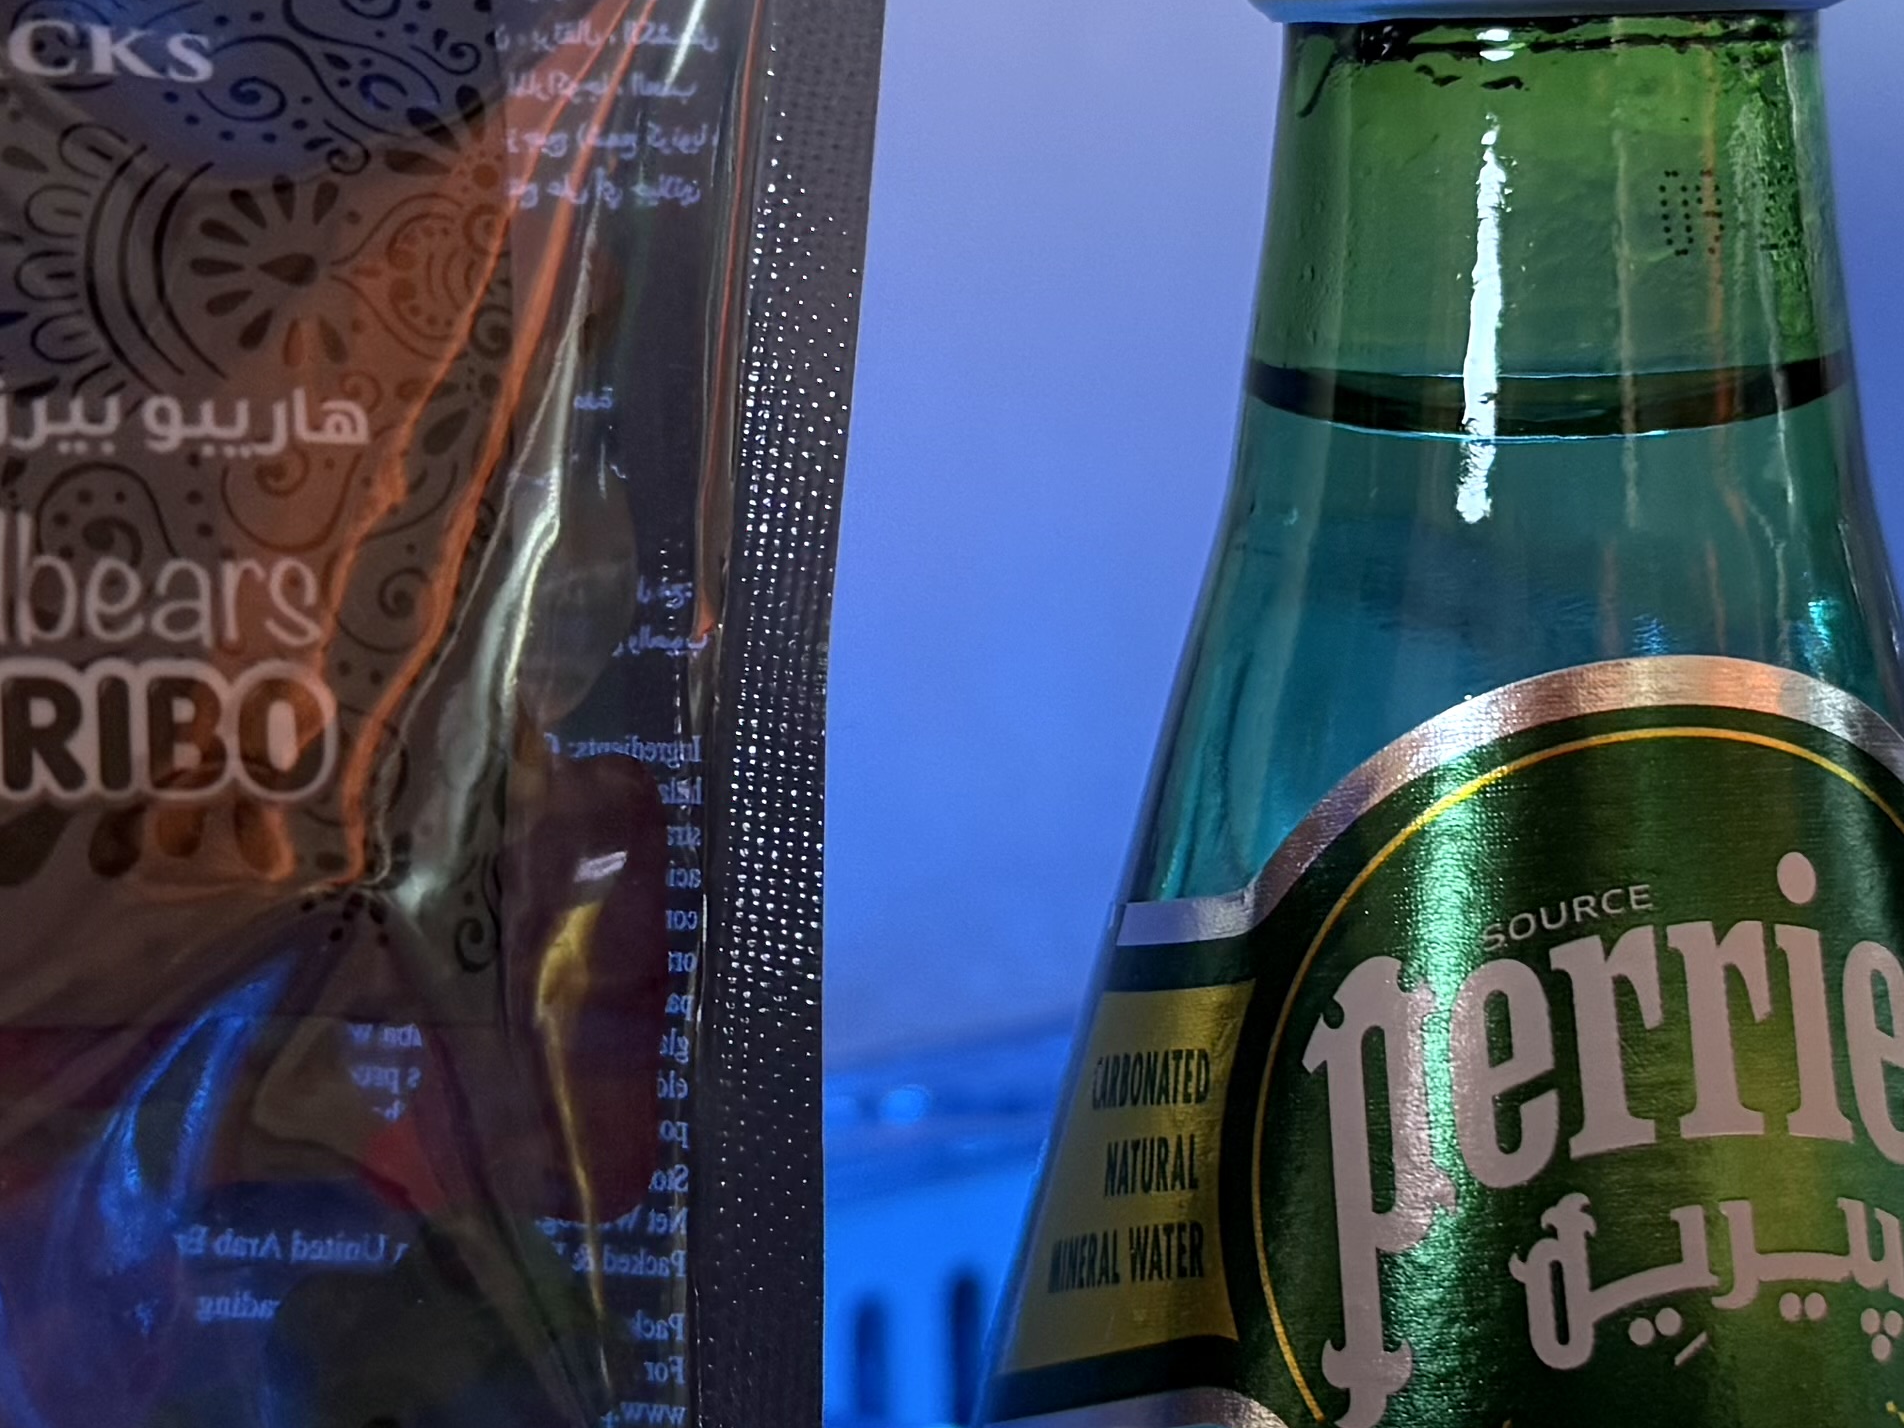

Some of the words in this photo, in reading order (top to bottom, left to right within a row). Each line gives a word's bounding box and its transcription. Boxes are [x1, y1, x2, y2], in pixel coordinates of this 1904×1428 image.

[1482, 883, 1655, 952] SOURCE
[1091, 1047, 1211, 1113] CARBONATED
[1103, 1133, 1200, 1199] NATURAL
[1047, 1234, 1121, 1296] MINERAL
[1127, 1218, 1205, 1286] WATER
